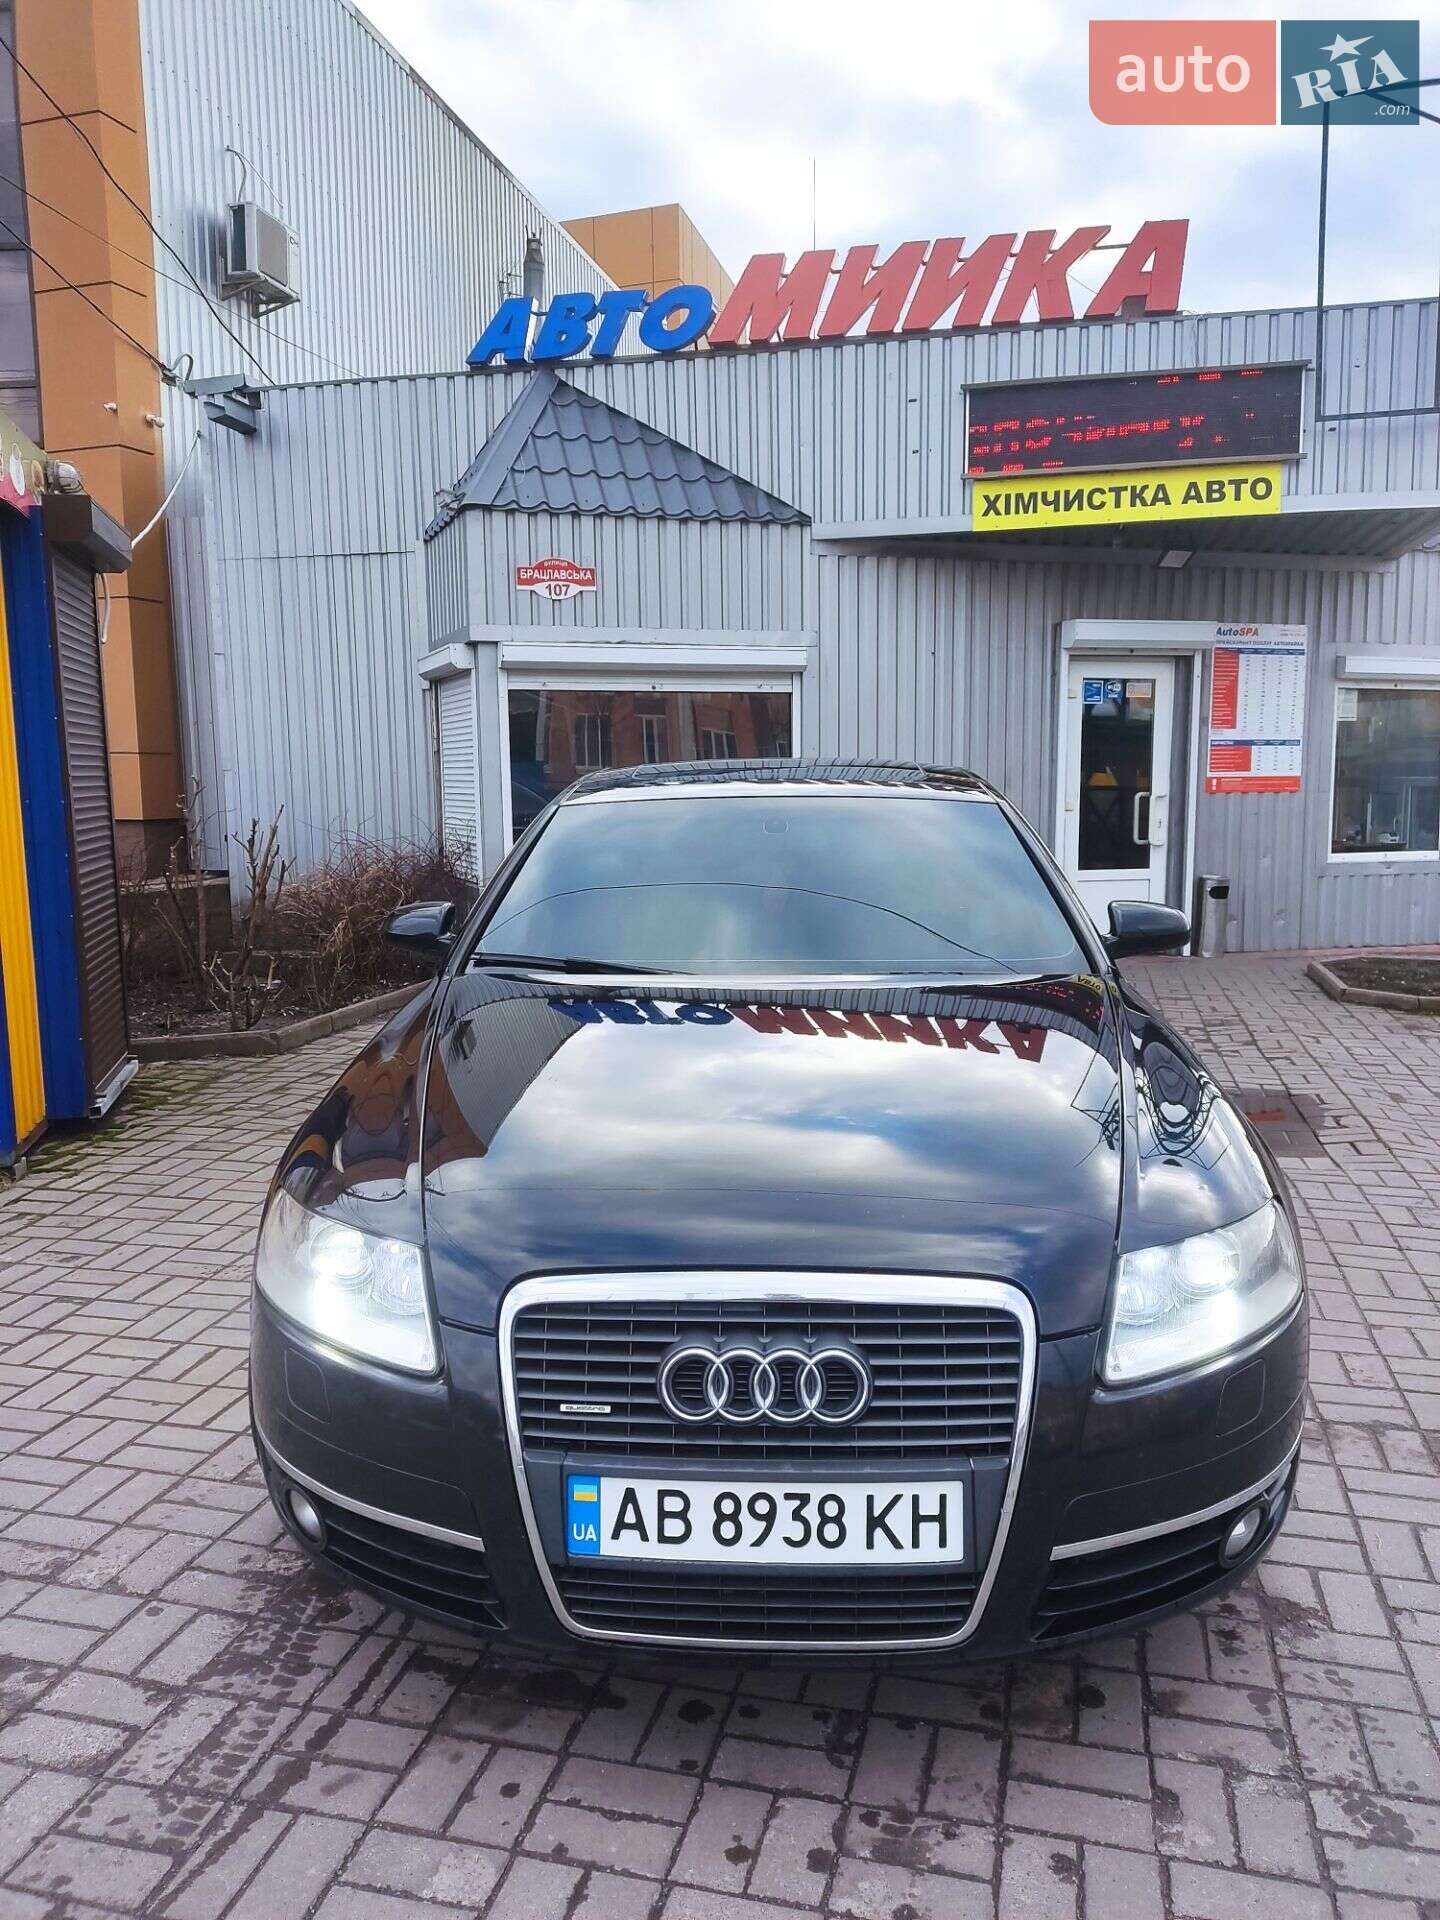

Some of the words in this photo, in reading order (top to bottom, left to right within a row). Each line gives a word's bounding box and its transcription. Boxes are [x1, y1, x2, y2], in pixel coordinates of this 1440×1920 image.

[981, 483, 1172, 518] ХІМЧИСТКА
[1181, 476, 1274, 505] АВТО
[520, 568, 593, 581] БРАЦЛАВСЬКА
[545, 583, 571, 597] 107
[1216, 626, 1259, 637] AutoSPA
[611, 1487, 692, 1545] AB
[712, 1491, 847, 1550] 8938
[866, 1493, 948, 1551] KH
[572, 1524, 598, 1542] UA
